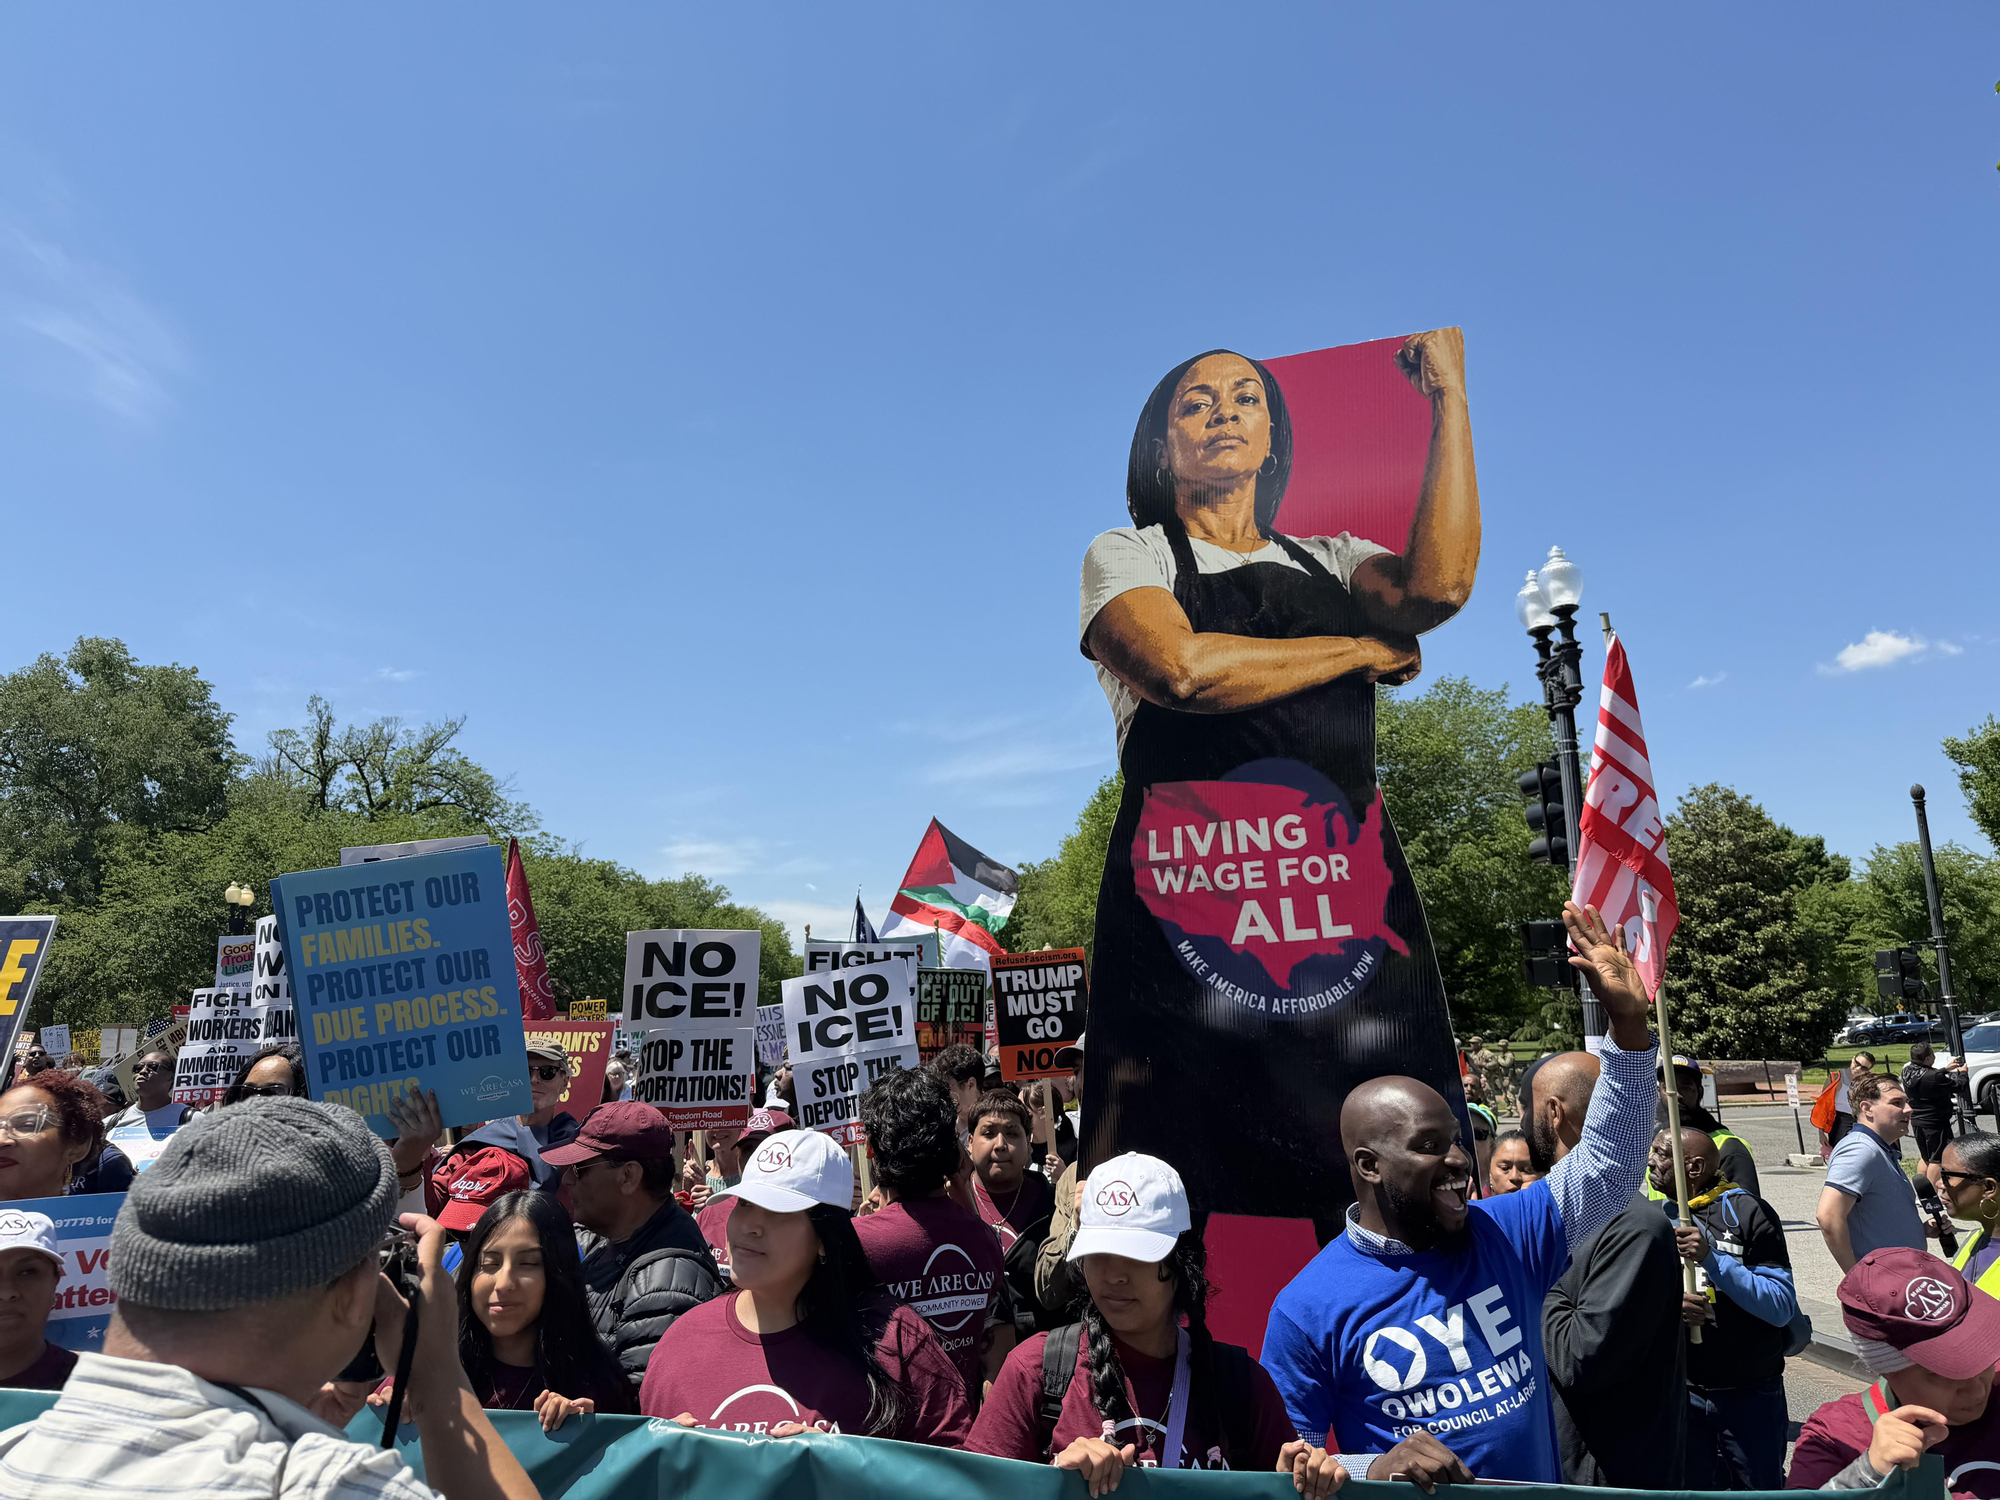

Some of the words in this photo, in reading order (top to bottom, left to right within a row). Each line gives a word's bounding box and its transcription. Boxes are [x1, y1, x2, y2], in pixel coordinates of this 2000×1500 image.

[1148, 813, 1308, 861] LIVING
[1151, 860, 1268, 894] WAGE
[1277, 853, 1351, 886] FOR
[295, 880, 415, 928] PROTECT
[424, 871, 480, 909] OUR
[1231, 894, 1353, 945] ALL
[223, 941, 256, 956] Good
[301, 918, 441, 967] FAMILIES.
[642, 941, 736, 977] NO
[995, 952, 1077, 965] RefuseFascism.org
[307, 958, 426, 1006] PROTECT
[436, 948, 491, 985] OUR
[995, 965, 1083, 992] TRUMP
[1177, 939, 1210, 976] MAKE
[1206, 972, 1266, 1012] AMERICA
[1271, 977, 1355, 1014] AFFORDABLE
[1355, 950, 1375, 982] NOW
[571, 1001, 605, 1013] POWER
[630, 982, 745, 1021] ICE!
[803, 974, 889, 1016] NO
[949, 984, 981, 1003] OUT
[1006, 990, 1076, 1017] MUST
[214, 1009, 240, 1017] FOR
[312, 1010, 368, 1045] DUE
[375, 986, 508, 1035] PROCESS.
[921, 1004, 940, 1021] OF
[1026, 1016, 1063, 1039] GO
[797, 1005, 904, 1053] ICE!
[921, 1033, 947, 1047] END
[951, 1033, 975, 1048] THE
[207, 1046, 238, 1054] AND
[318, 1034, 437, 1084] PROTECT
[446, 1024, 501, 1062] OUR
[639, 1039, 683, 1077] STOP
[691, 1039, 733, 1072] THE
[460, 1087, 476, 1096] WE
[479, 1083, 498, 1092] ARE
[500, 1079, 524, 1089] CASA
[812, 1062, 859, 1098] STOP
[669, 1111, 700, 1120] Freedom
[702, 1111, 723, 1119] Road
[699, 1119, 745, 1130] Organization
[803, 1094, 862, 1127] DEPORT
[757, 1150, 792, 1169] CASA
[1096, 1190, 1141, 1206] CASA
[55, 1217, 94, 1228] 97779
[97, 1216, 113, 1225] for
[887, 1279, 922, 1299] WE
[927, 1274, 962, 1295] ARE
[915, 1300, 959, 1313] COMMUNITY
[961, 1297, 985, 1306] POWER
[1363, 1284, 1523, 1392] OYE
[1381, 1349, 1532, 1420] OWOLEWA
[1392, 1424, 1424, 1438] FOR
[1427, 1408, 1495, 1435] COUNCIL
[1496, 1376, 1537, 1417] AT-LARGE
